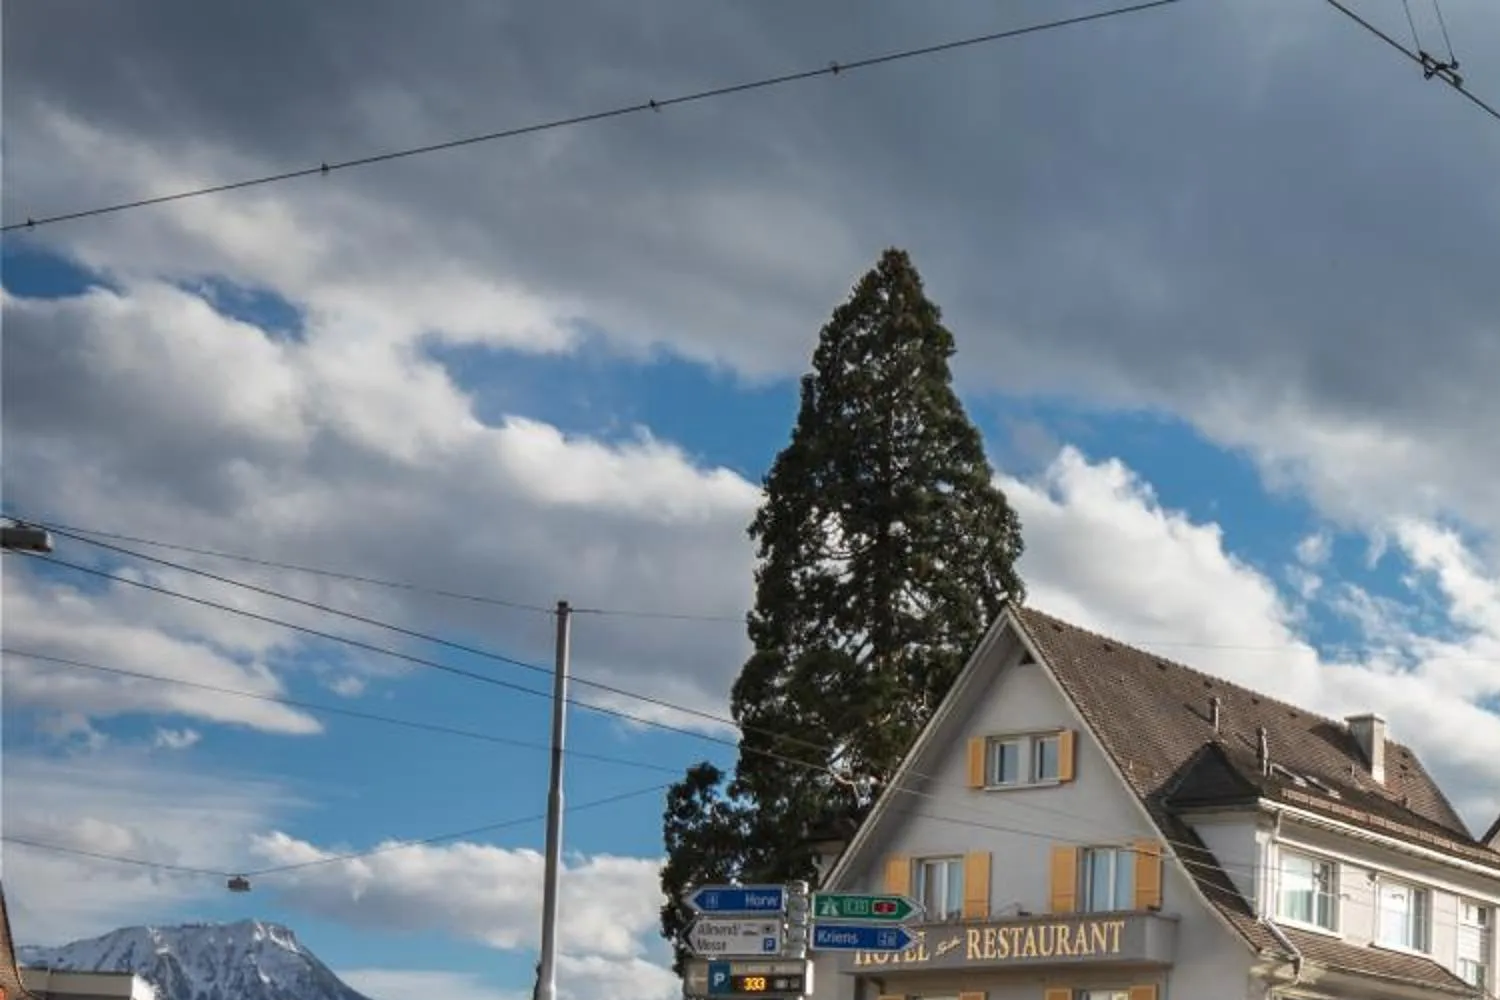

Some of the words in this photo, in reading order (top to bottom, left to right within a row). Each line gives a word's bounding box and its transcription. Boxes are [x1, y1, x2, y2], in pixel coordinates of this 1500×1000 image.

[745, 892, 778, 908] Horw
[817, 930, 860, 945] Kriens
[966, 921, 1124, 960] RESTAURANT
[713, 972, 725, 987] P
[743, 977, 766, 991] 333
